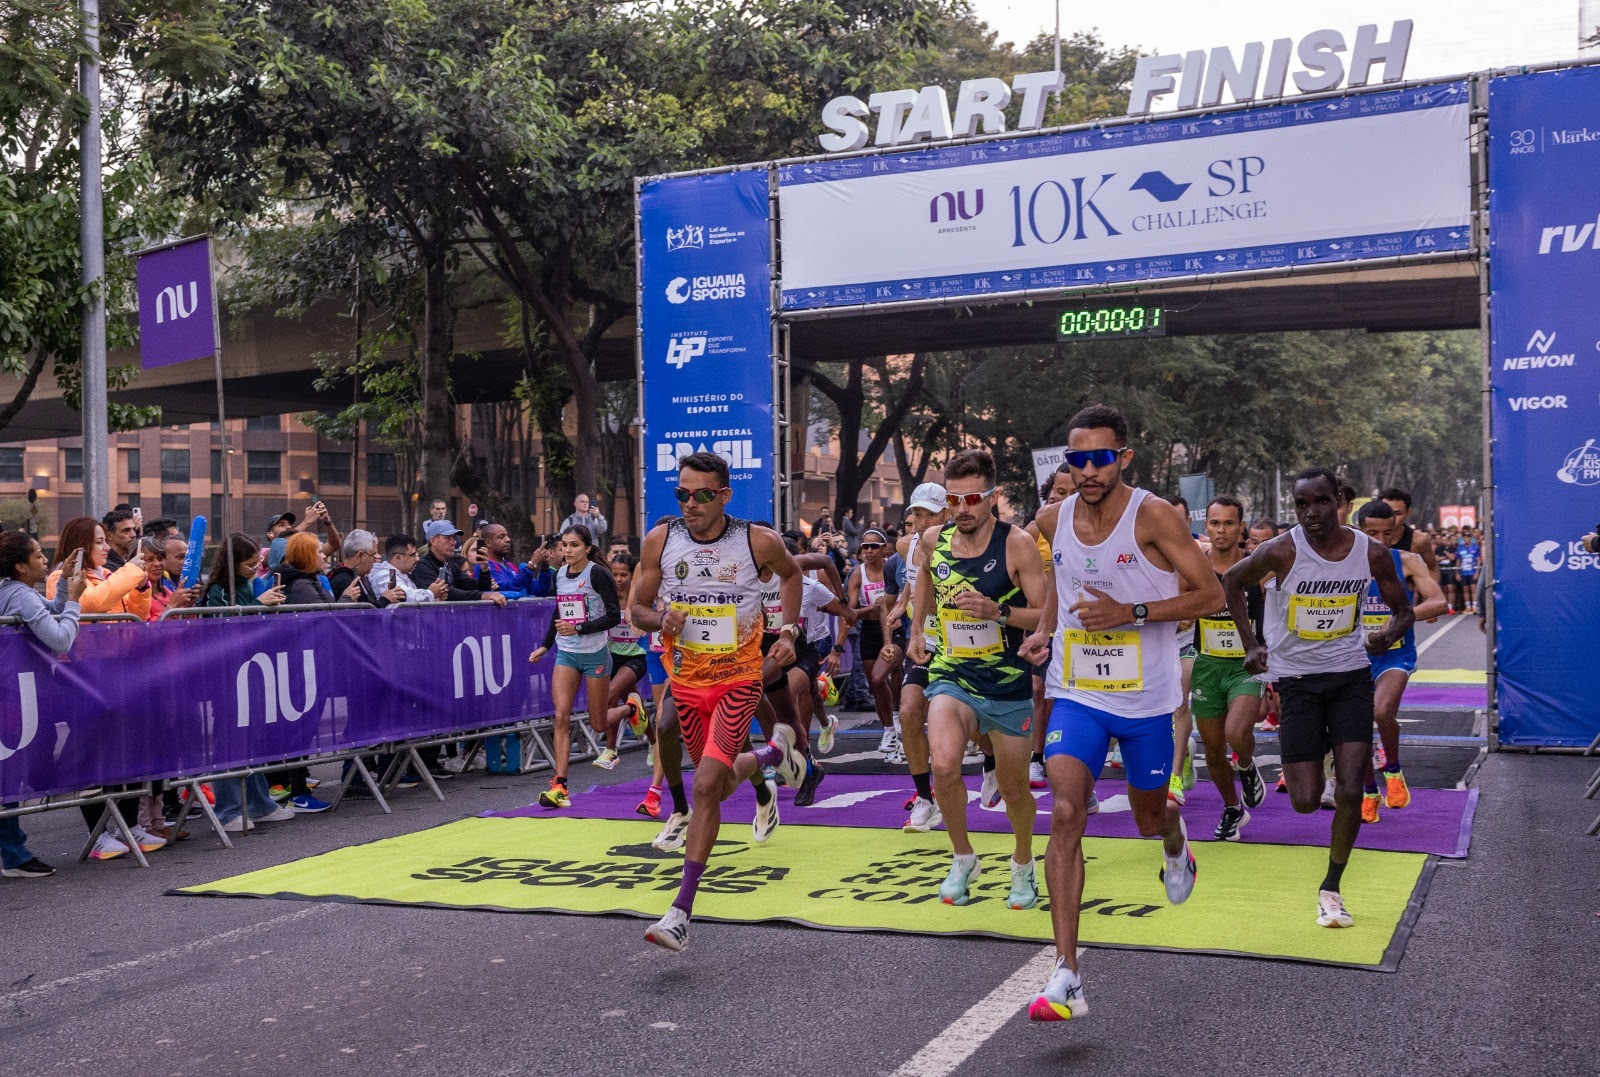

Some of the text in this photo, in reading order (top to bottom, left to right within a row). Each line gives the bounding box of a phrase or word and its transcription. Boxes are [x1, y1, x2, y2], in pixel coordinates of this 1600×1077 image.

[818, 19, 1414, 152] START FINISH
[1510, 129, 1535, 147] 30
[1510, 145, 1535, 155] ANOS
[1208, 156, 1266, 198] SP
[1008, 172, 1123, 248] 10K
[1131, 200, 1267, 232] CHALLENGE
[937, 226, 977, 234] APRESENTA
[693, 274, 745, 289] IGUANA
[692, 286, 745, 301] SPORTS
[1061, 308, 1160, 334] 00:00:01
[1503, 354, 1575, 370] NEWON
[672, 394, 726, 404] MINISTÉRIO
[1508, 395, 1568, 411] VIGOR
[687, 405, 729, 414] ESPORTE
[665, 429, 752, 438] GOVERNO FEDERAL
[1296, 579, 1368, 594] OLYMPIKUS
[1317, 620, 1334, 629] 27
[701, 630, 710, 641] 2
[969, 636, 974, 645] 1
[1084, 633, 1102, 645] 10K
[1082, 648, 1124, 656] WALACE
[1096, 663, 1110, 676] 11
[450, 856, 790, 881] IGUANA
[410, 867, 767, 894] SPORTS
